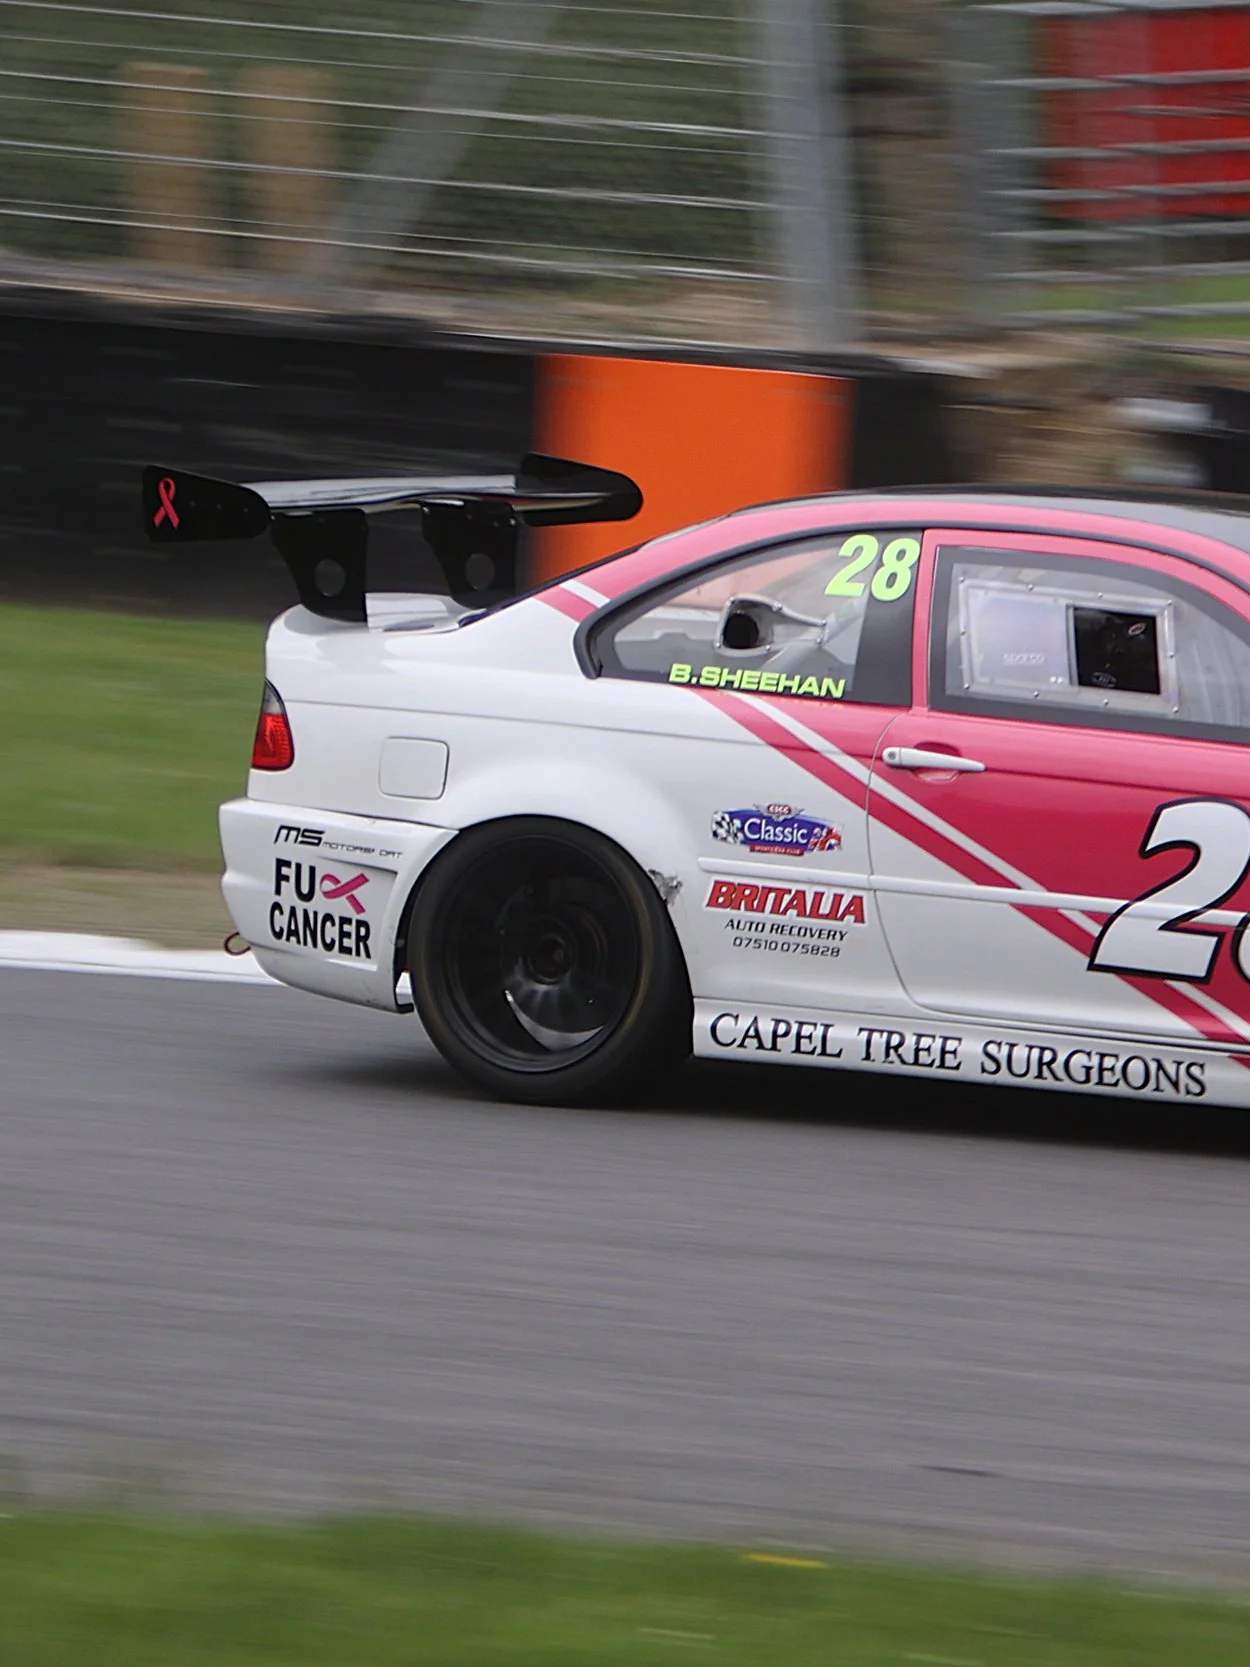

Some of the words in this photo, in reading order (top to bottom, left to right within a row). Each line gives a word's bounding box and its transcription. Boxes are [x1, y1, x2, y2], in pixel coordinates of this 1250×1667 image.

[824, 534, 920, 602] 28
[668, 663, 846, 698] B.SHEEHAN
[274, 825, 325, 847] MS
[743, 818, 808, 844] Classic
[706, 880, 866, 924] BRITALIA
[269, 901, 372, 960] CANCER
[724, 918, 766, 934] AUTO
[769, 923, 848, 942] RECOVERY
[709, 1013, 844, 1060] CAPEL
[857, 1027, 962, 1071] TREE
[980, 1040, 1207, 1097] SURGEONS
